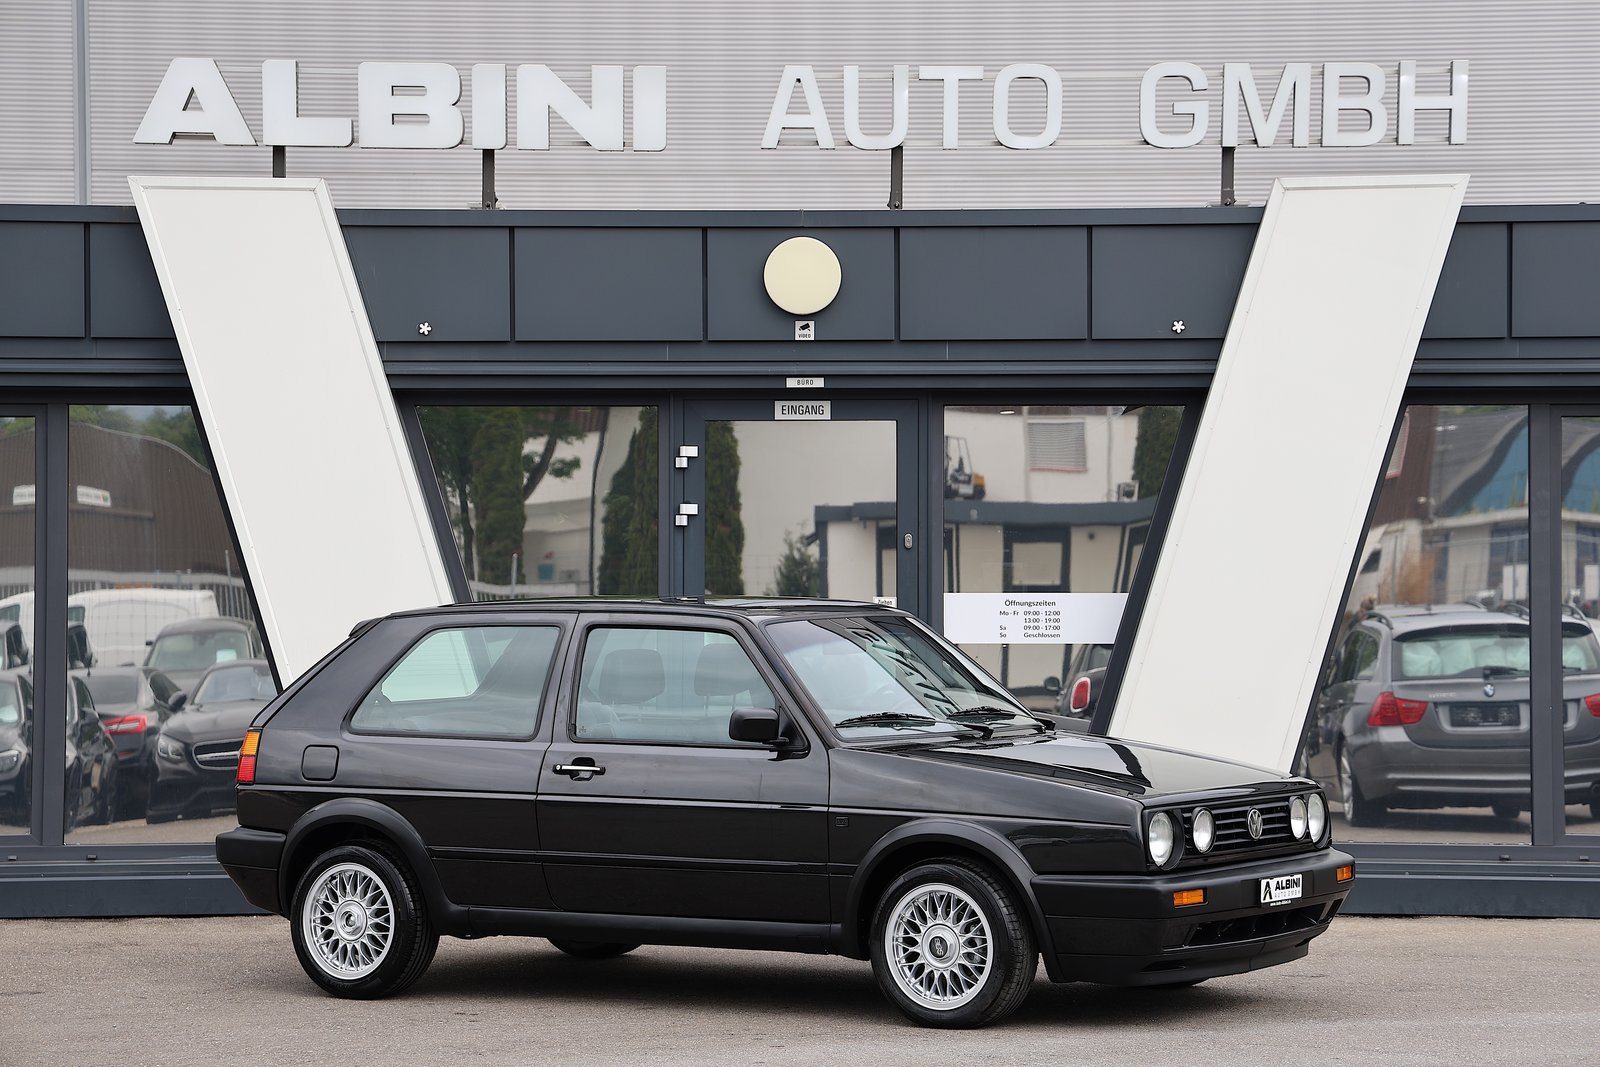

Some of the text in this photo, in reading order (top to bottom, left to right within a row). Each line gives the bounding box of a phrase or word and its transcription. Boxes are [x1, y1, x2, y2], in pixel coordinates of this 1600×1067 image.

[133, 57, 1469, 152] ALBINI AUTO GMBH
[797, 378, 814, 386] BÜRO
[781, 404, 825, 416] EINGANG
[1004, 599, 1056, 608] Öffnungszeiten
[1274, 877, 1301, 892] ALBINI
